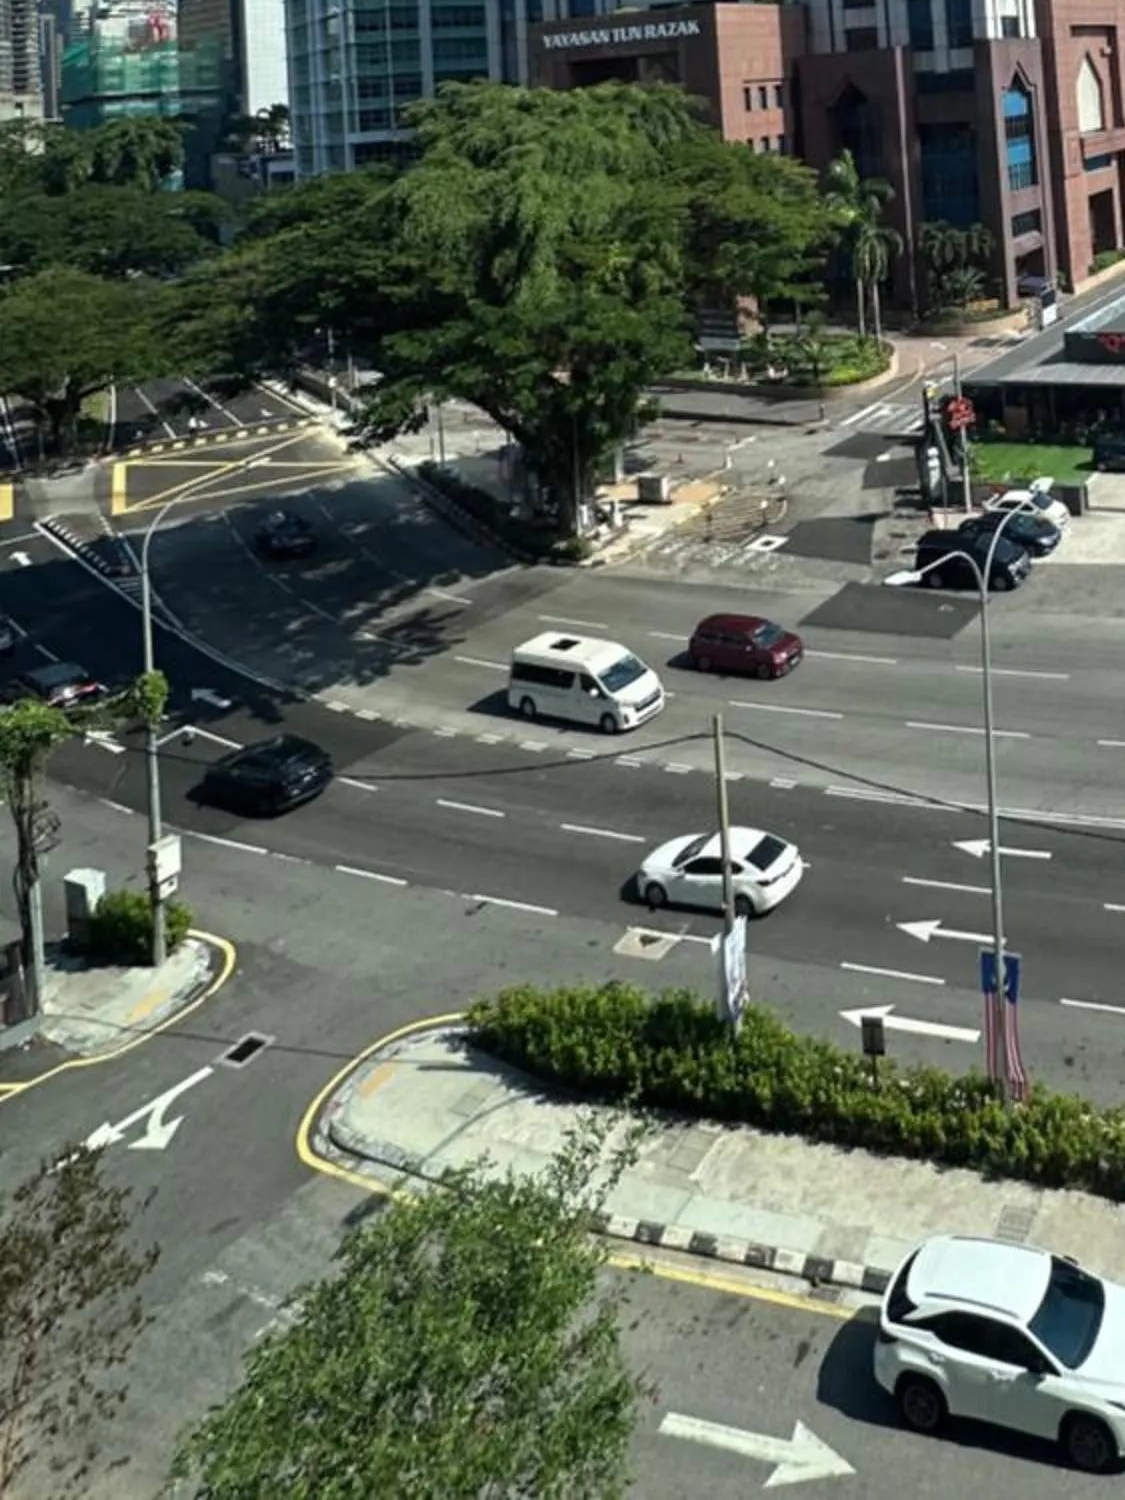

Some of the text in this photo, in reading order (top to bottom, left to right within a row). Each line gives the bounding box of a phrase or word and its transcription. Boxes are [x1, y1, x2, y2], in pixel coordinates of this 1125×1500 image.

[543, 19, 700, 49] YAYASAN TUN RAZAK
